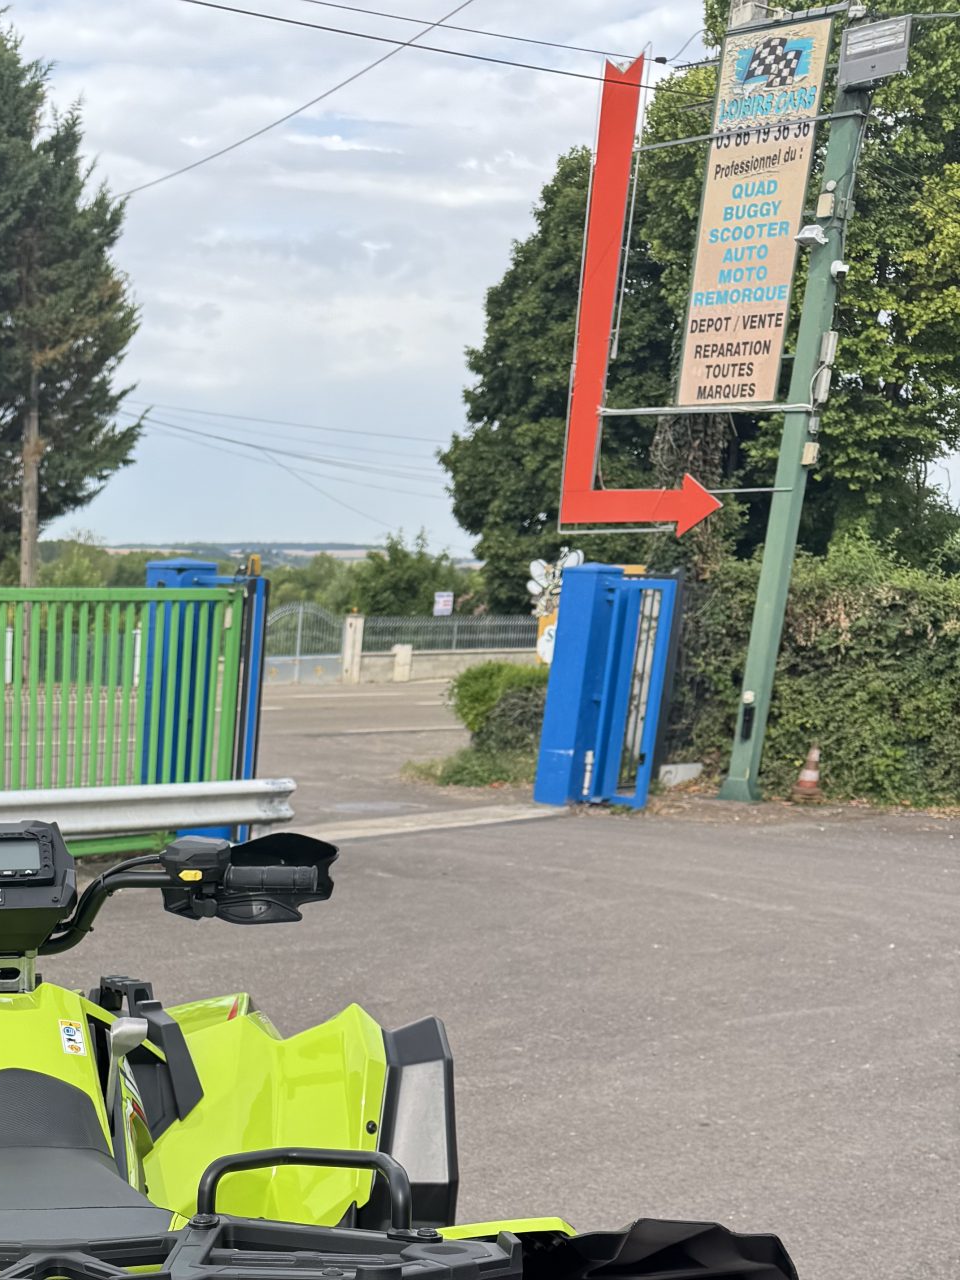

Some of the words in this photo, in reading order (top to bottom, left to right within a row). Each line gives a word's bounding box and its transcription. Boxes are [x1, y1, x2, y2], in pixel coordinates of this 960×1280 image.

[719, 92, 775, 125] LOISIRS
[775, 85, 817, 114] CARS
[714, 149, 781, 180] Professionnel
[784, 146, 797, 163] du
[731, 179, 778, 200] QUAD
[723, 200, 782, 222] BUGGY
[708, 220, 790, 244] SCOOTER
[722, 244, 769, 263] AUTO
[718, 265, 768, 285] MOTO
[693, 284, 789, 307] REMORQUE
[690, 316, 732, 334] DEPOT
[742, 312, 784, 330] VENTE
[694, 339, 772, 359] REPARATION
[705, 361, 754, 379] TOUTES
[696, 383, 756, 400] MARQUES
